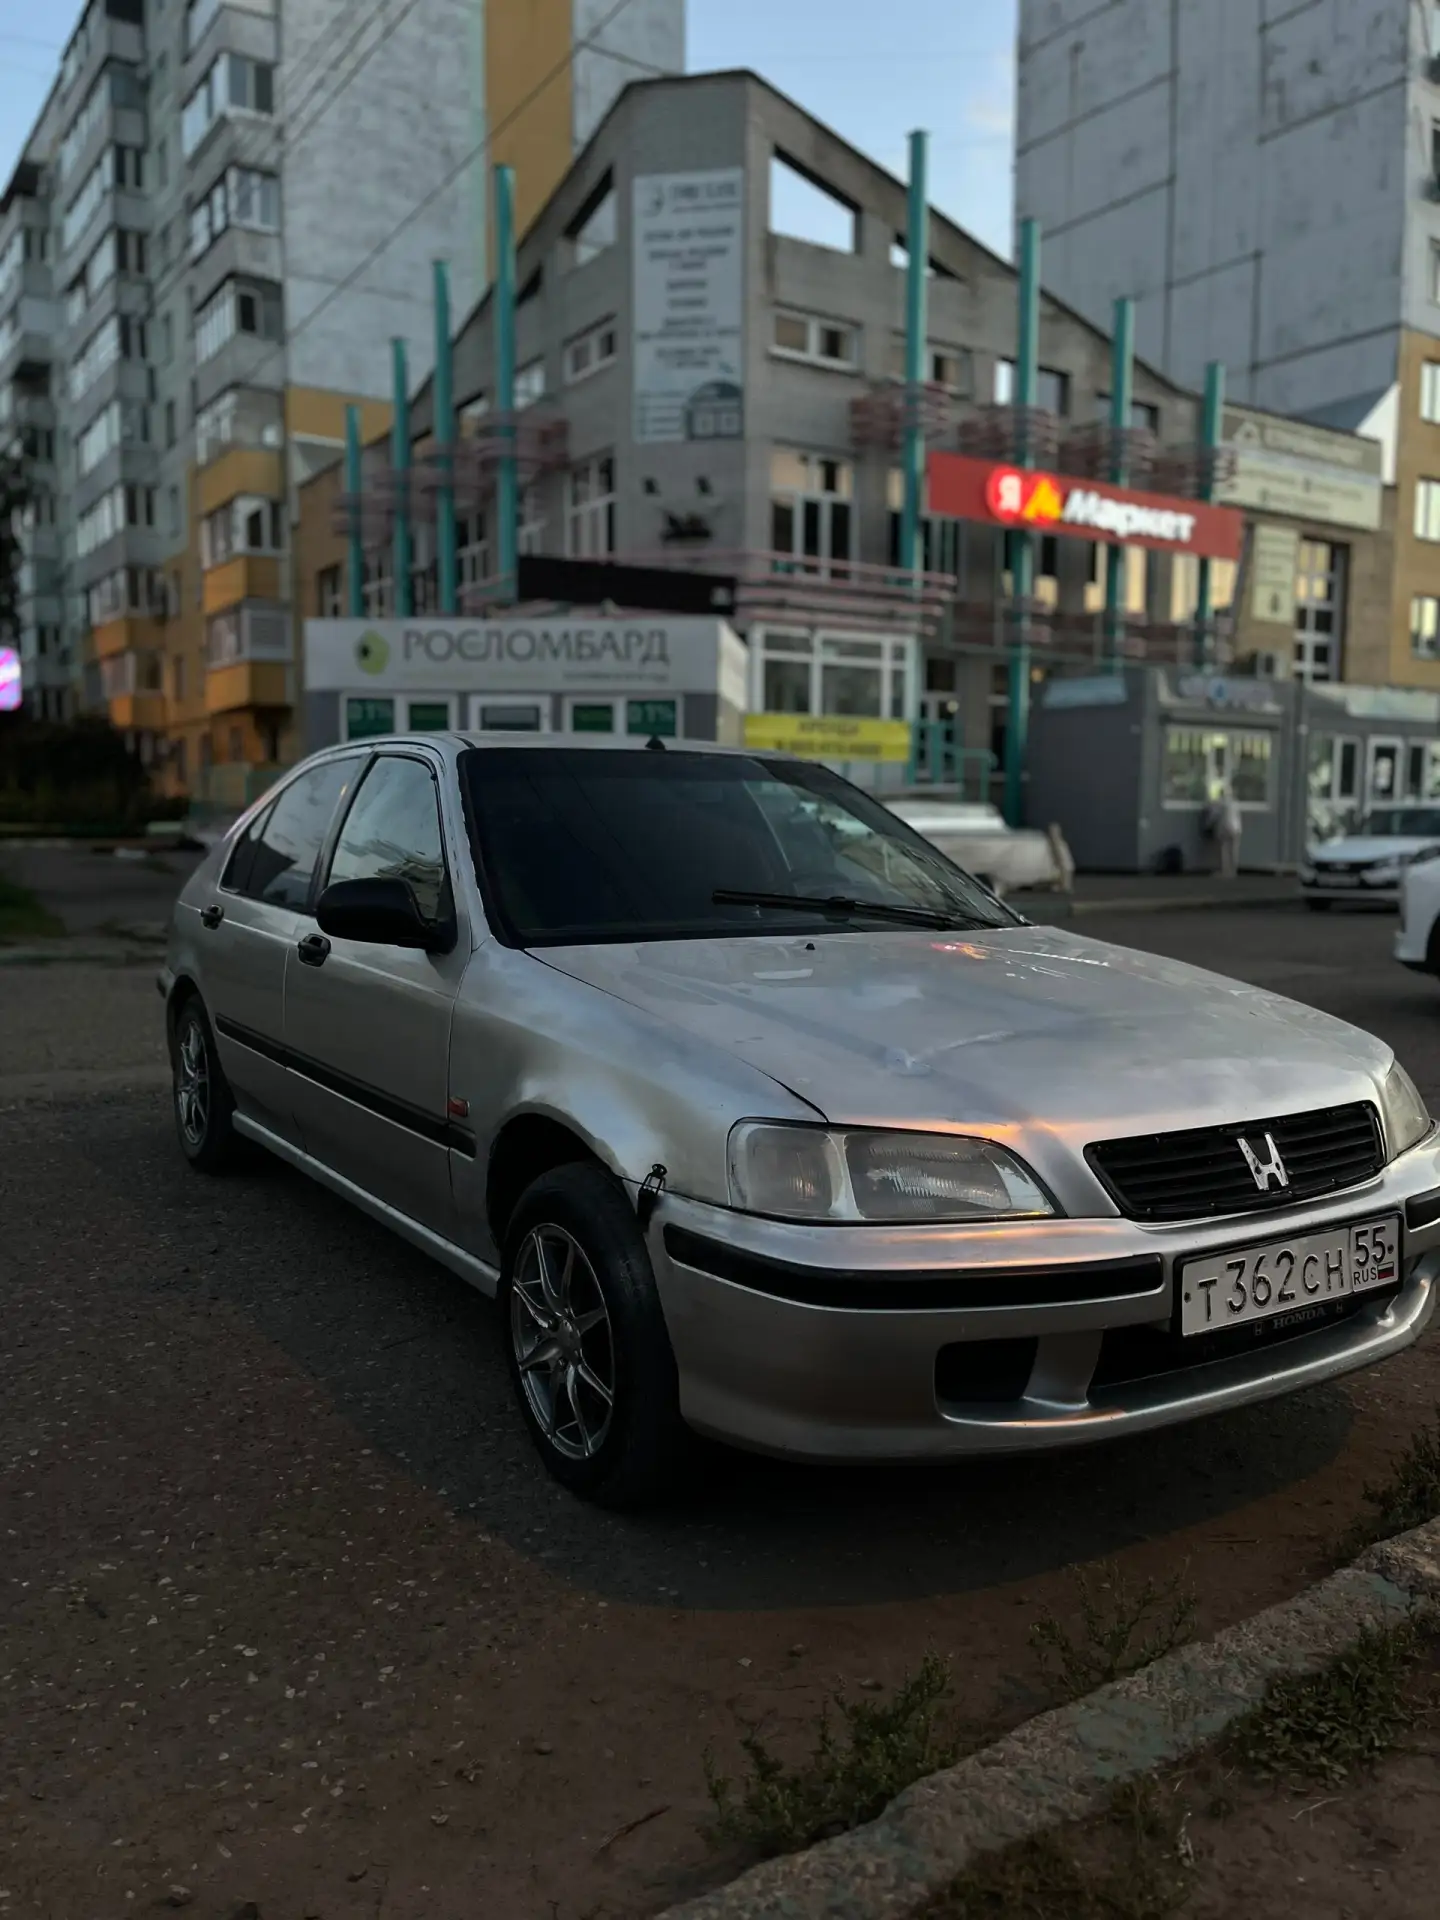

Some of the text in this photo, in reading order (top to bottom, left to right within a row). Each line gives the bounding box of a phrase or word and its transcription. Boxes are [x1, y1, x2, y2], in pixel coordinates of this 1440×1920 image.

[1062, 488, 1195, 543] Маркет
[402, 629, 670, 666] РОСЛОМБАРД
[1354, 1225, 1387, 1266] 55
[1353, 1270, 1377, 1286] RUS
[1273, 1307, 1327, 1329] HONDA
